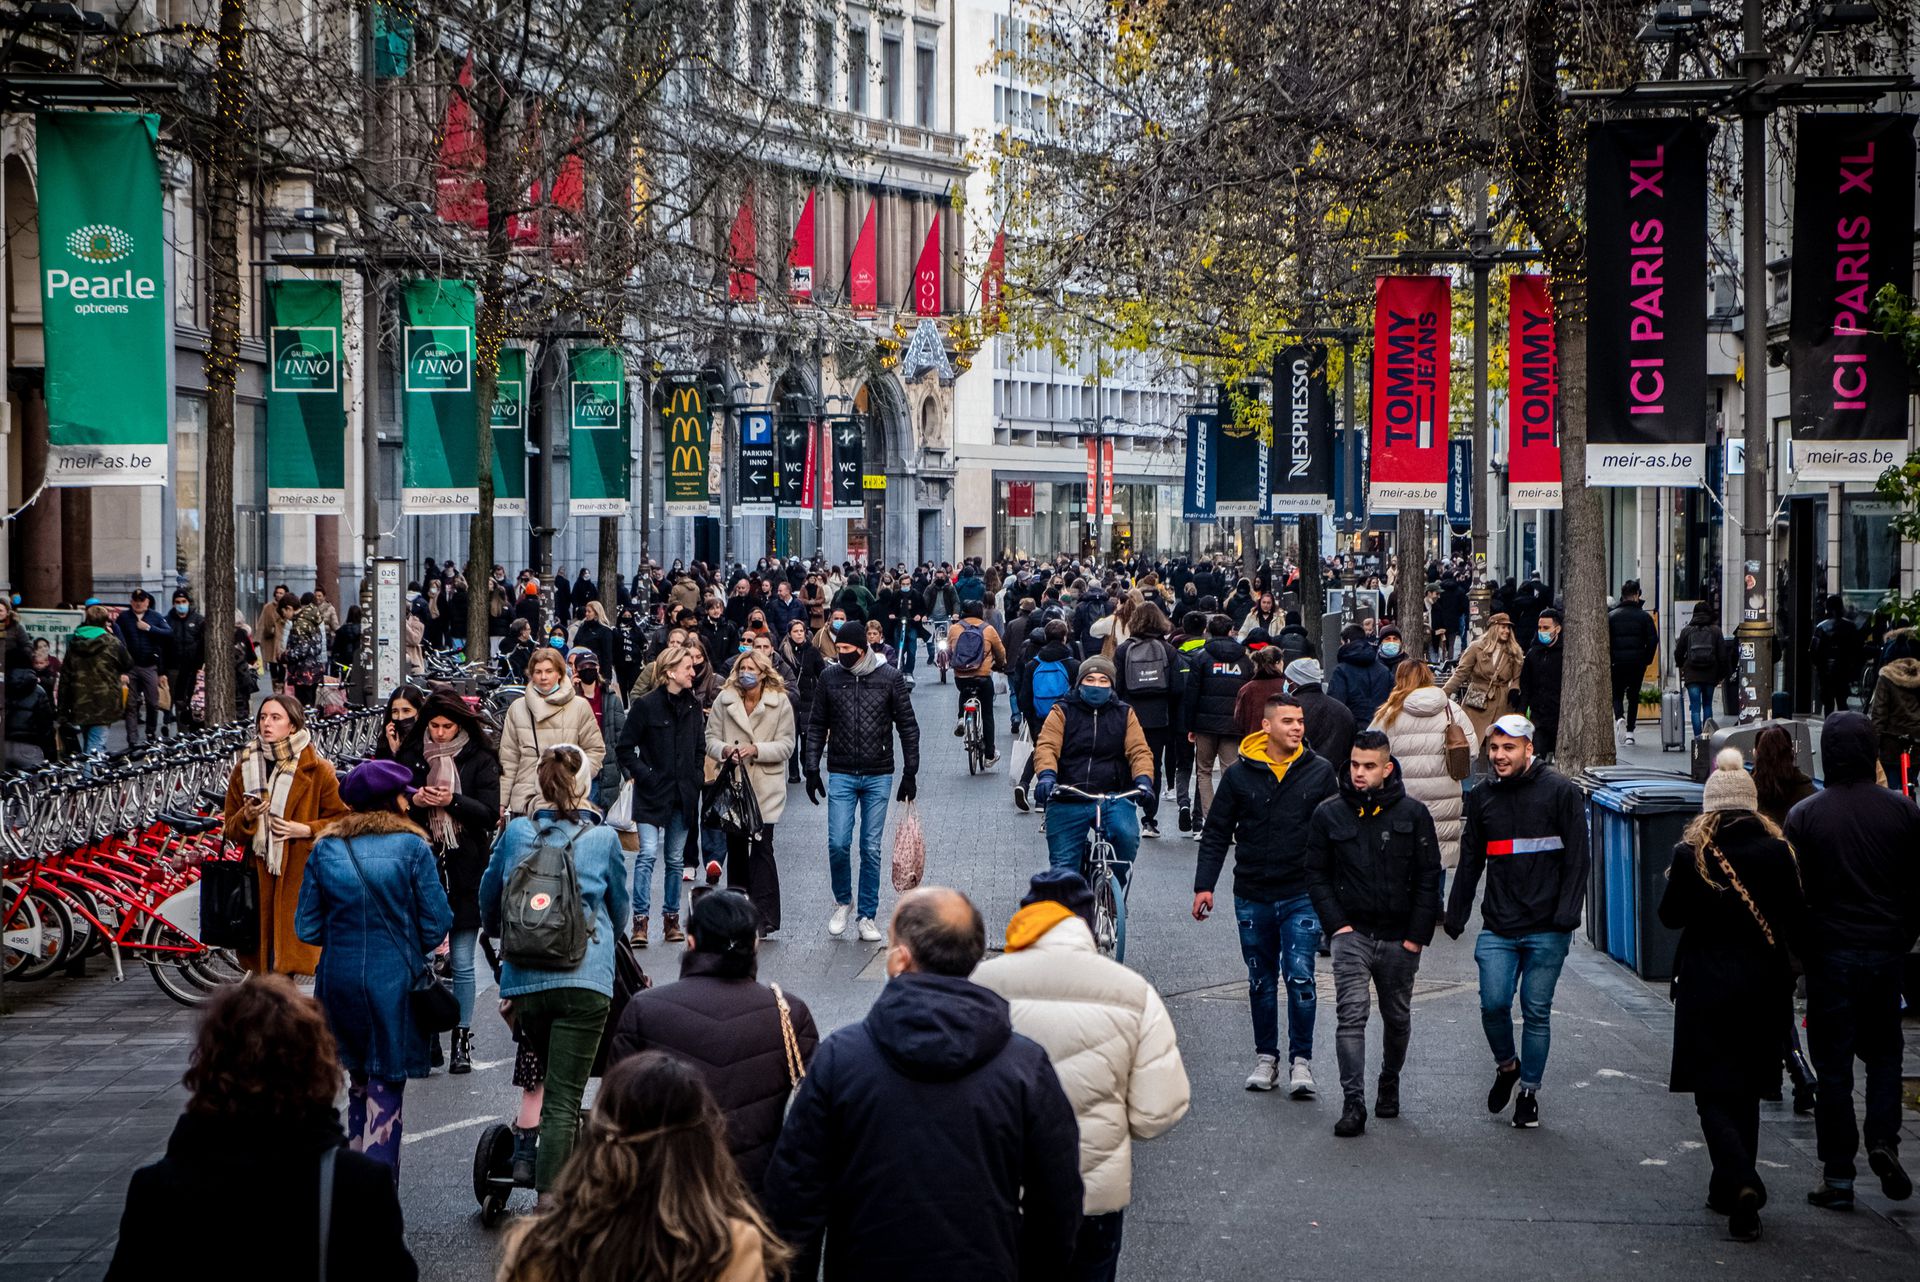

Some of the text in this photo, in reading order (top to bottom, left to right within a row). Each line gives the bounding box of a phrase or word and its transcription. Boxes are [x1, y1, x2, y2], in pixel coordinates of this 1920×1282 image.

[1629, 145, 1665, 414] ICI PARIS XL
[1833, 141, 1875, 410] ICI PARIS XL
[47, 269, 155, 299] Pearle
[921, 270, 935, 311] COS
[74, 303, 129, 315] opticiens
[1417, 311, 1438, 392] JEANS
[284, 359, 330, 375] INNO
[417, 359, 463, 374] INNO
[1385, 310, 1416, 448] TOMMY
[1522, 310, 1550, 448] TOMMY
[492, 404, 517, 416] NNO
[581, 404, 615, 416] INNO
[1288, 358, 1312, 482] NESPRESSO
[750, 417, 767, 441] P
[742, 449, 773, 457] PARKING
[1807, 449, 1894, 464] meir-as.be
[58, 452, 152, 470] meir-as.be
[784, 462, 802, 472] WC
[838, 462, 856, 472] WC
[1196, 420, 1207, 509] SKECHERS
[1602, 452, 1692, 469] meir-as.be
[1259, 438, 1269, 511] SKECHE
[278, 493, 336, 505] meir-as.be
[411, 493, 470, 505] meir-as.be
[1379, 488, 1438, 498] meir-as.be
[1518, 488, 1561, 498] meir-as.
[577, 501, 620, 510] meir-as.be
[1278, 498, 1322, 506] meir-as.be
[381, 568, 396, 577] 026
[25, 624, 71, 633] WE'RE OPEN!
[1212, 662, 1242, 675] FILA
[11, 936, 29, 945] 4965
